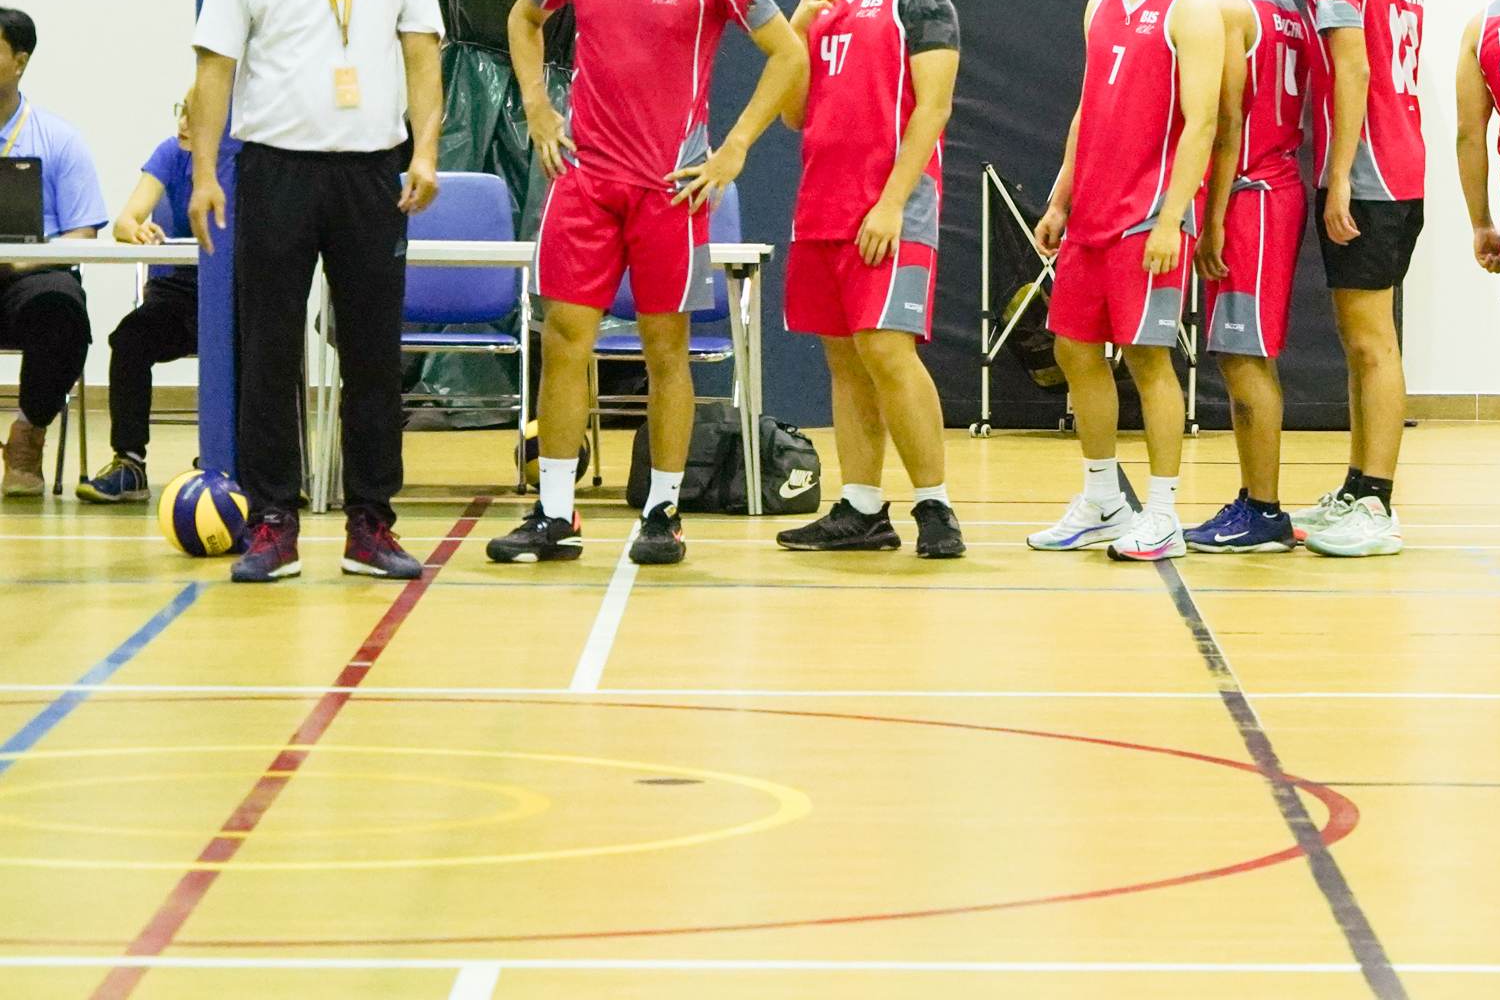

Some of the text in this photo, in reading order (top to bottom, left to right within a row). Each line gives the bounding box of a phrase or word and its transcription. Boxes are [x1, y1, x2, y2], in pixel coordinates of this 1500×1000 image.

[1140, 10, 1159, 24] BIS
[820, 33, 853, 76] 47
[1108, 45, 1126, 86] 7
[789, 469, 814, 487] NIKE
